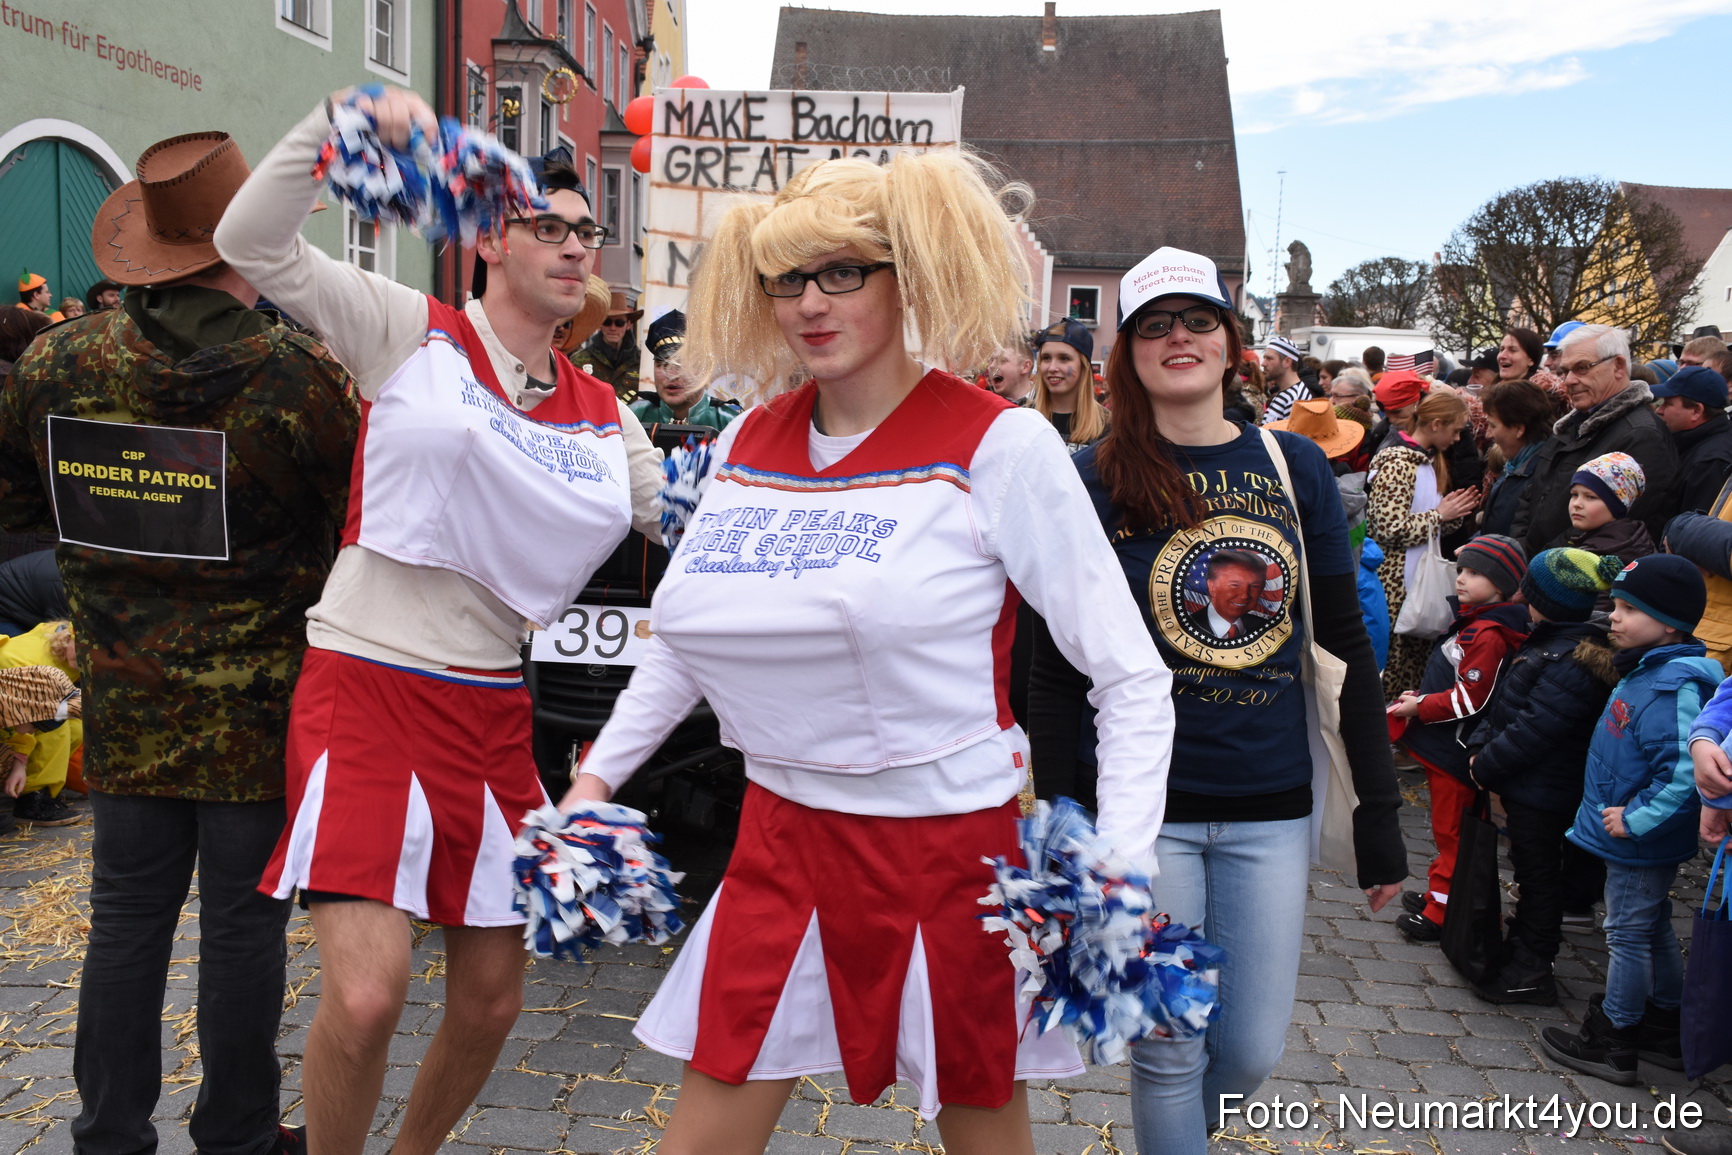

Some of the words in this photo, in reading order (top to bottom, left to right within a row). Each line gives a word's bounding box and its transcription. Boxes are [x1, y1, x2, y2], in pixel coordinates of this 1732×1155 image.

[61, 21, 90, 52] für
[96, 34, 203, 91] Ergotherapie
[665, 96, 767, 141] MAKE
[791, 96, 934, 145] Bacham
[664, 145, 810, 192] GREAT
[1133, 269, 1160, 287] Make
[1162, 265, 1206, 277] Bacham
[1137, 277, 1166, 293] Great
[1168, 275, 1204, 285] Again!
[122, 450, 146, 461] CBP
[58, 460, 133, 482] BORDER
[138, 469, 217, 490] PATROL
[558, 463, 603, 482] Squad
[89, 486, 140, 500] FEDERAL
[142, 491, 183, 503] AGENT
[696, 507, 778, 534] TWIN
[781, 509, 898, 538] PEAKS
[1231, 524, 1246, 534] OF
[1249, 527, 1274, 541] THE
[679, 529, 750, 558] HIGH
[755, 533, 881, 563] SCHOOL
[685, 553, 786, 578] Cheerleading
[784, 554, 844, 580] Squad
[1157, 591, 1169, 614] THE
[554, 607, 629, 659] 39
[1162, 615, 1174, 629] OF
[1174, 628, 1214, 662] SEAL
